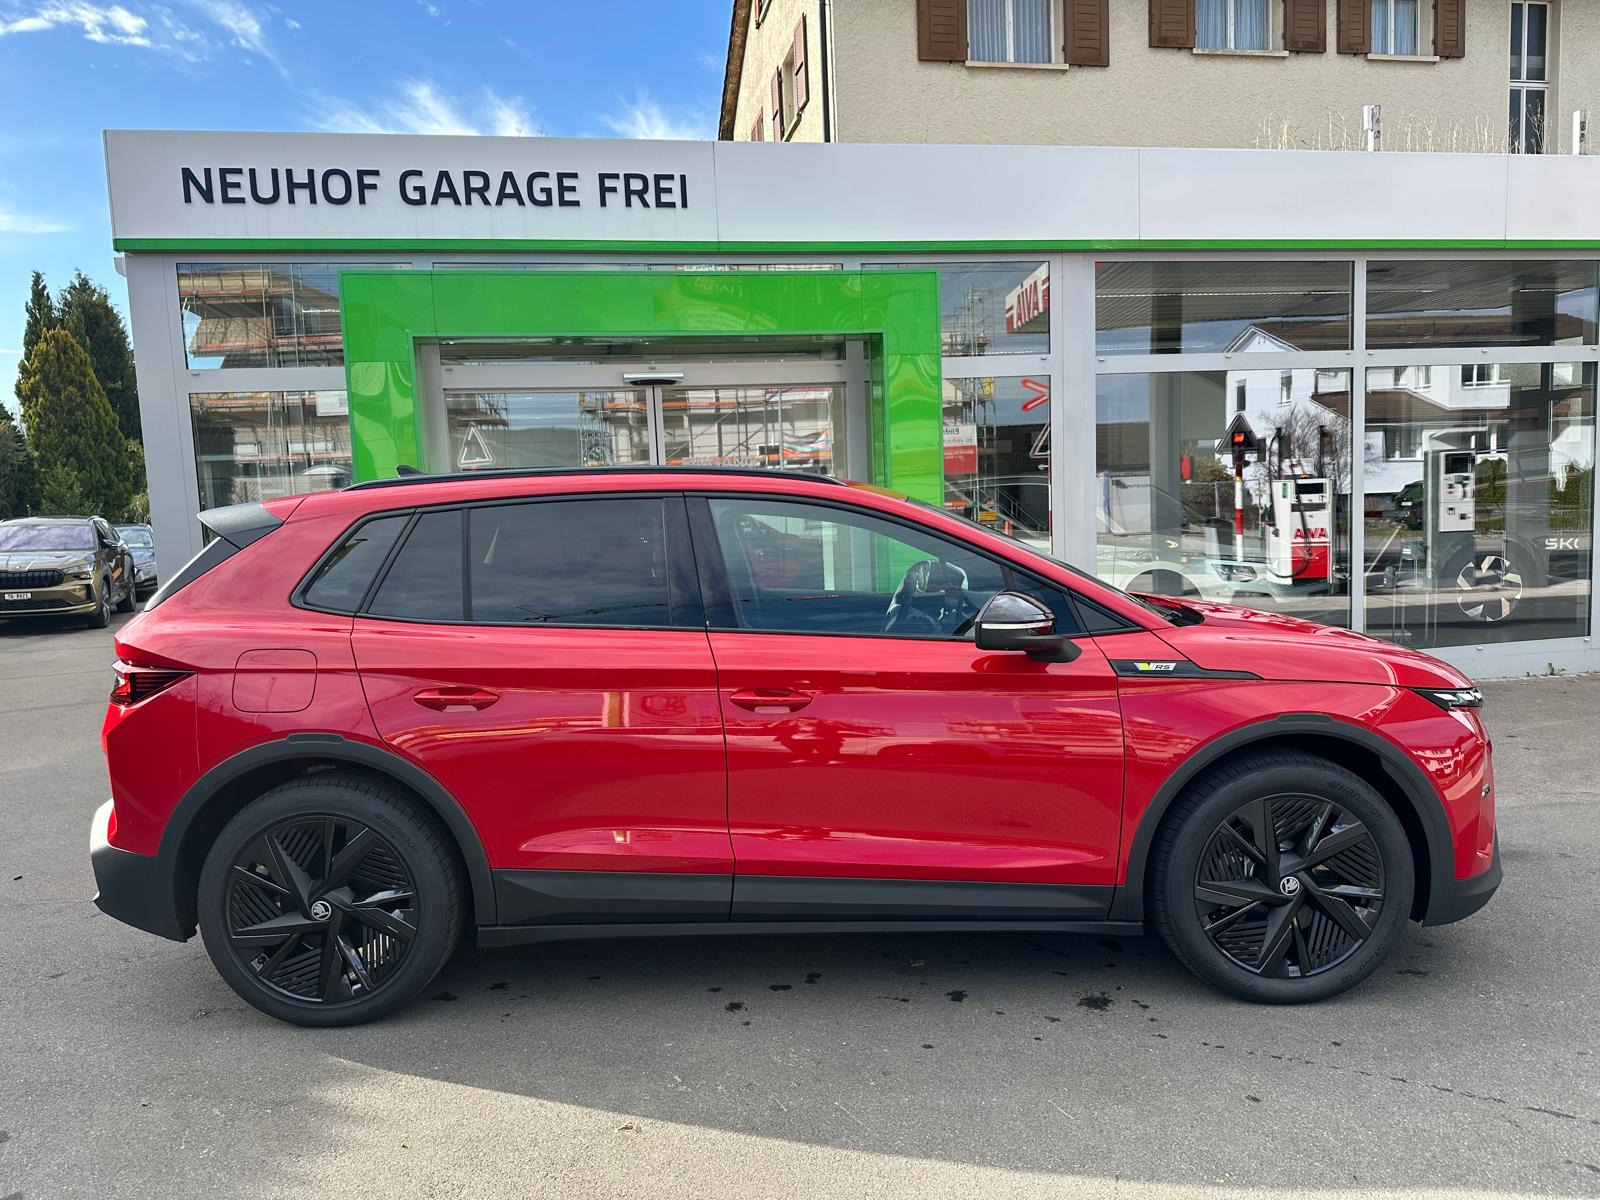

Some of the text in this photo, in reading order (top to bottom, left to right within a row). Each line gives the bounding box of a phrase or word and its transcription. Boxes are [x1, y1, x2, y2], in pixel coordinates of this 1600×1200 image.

[180, 166, 689, 209] NEUHOF GARAGE FREI
